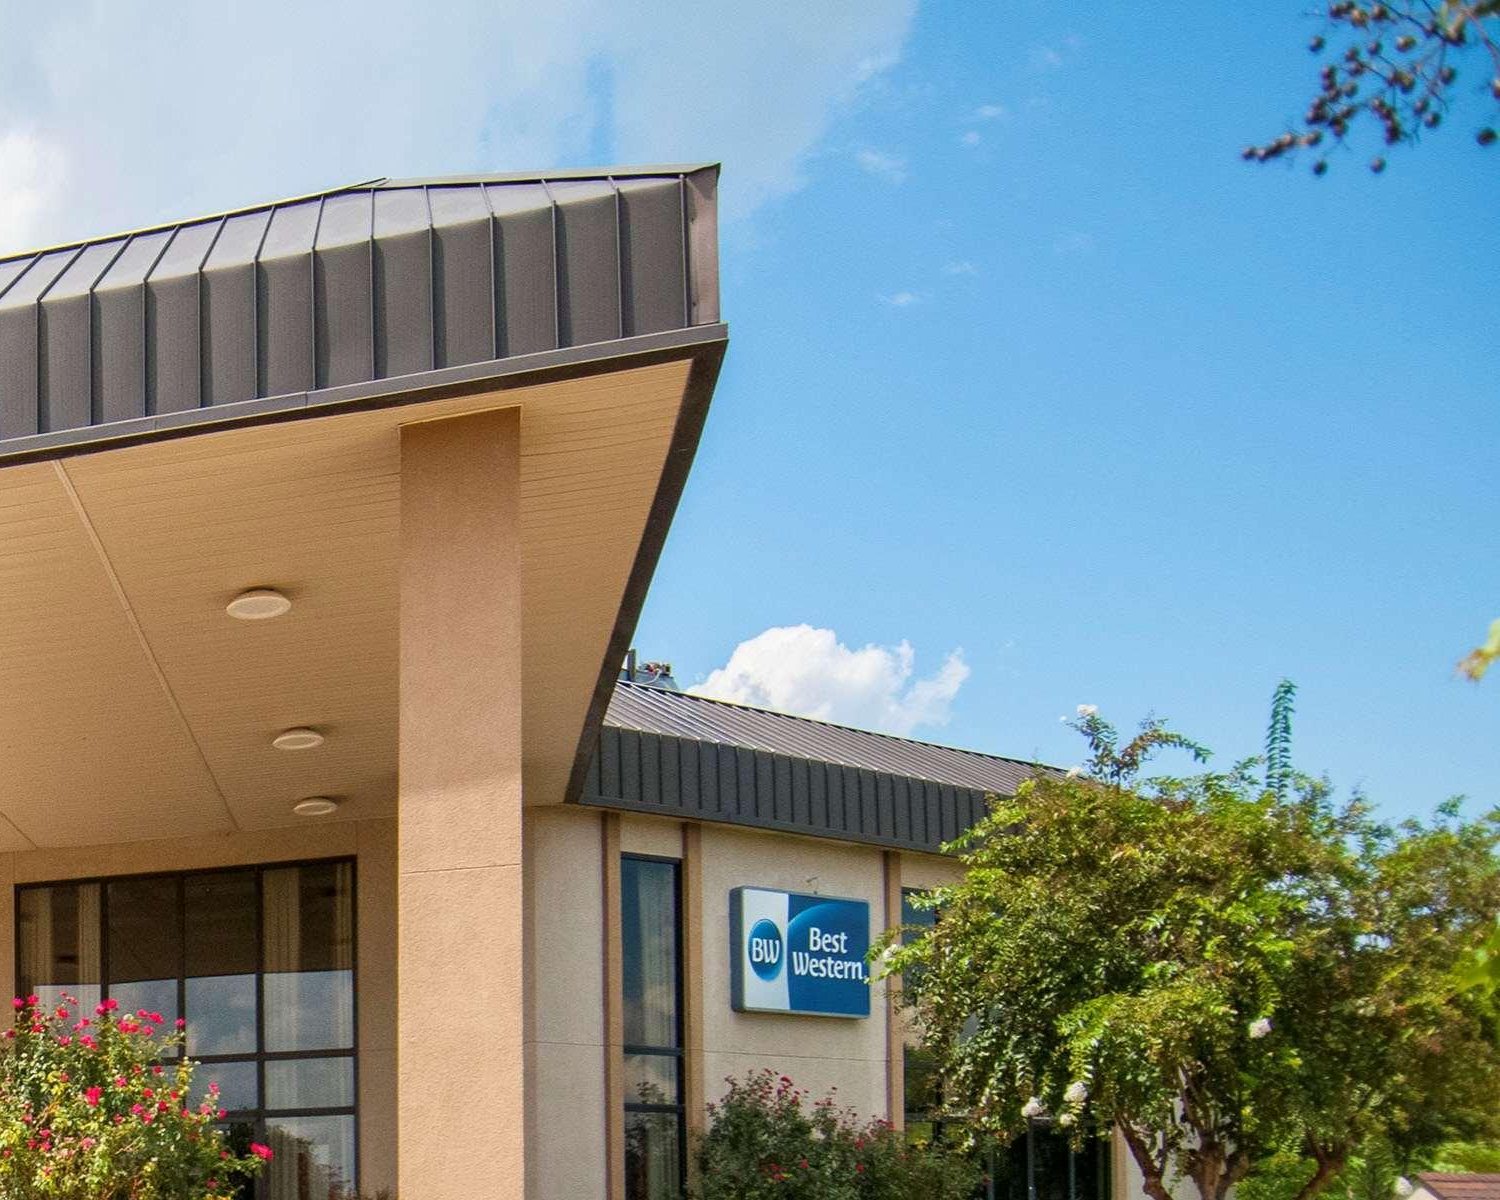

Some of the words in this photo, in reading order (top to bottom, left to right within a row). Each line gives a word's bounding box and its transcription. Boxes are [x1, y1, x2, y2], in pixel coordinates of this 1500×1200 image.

[752, 938, 780, 964] BW
[809, 927, 848, 954] Best
[793, 951, 863, 980] Western
